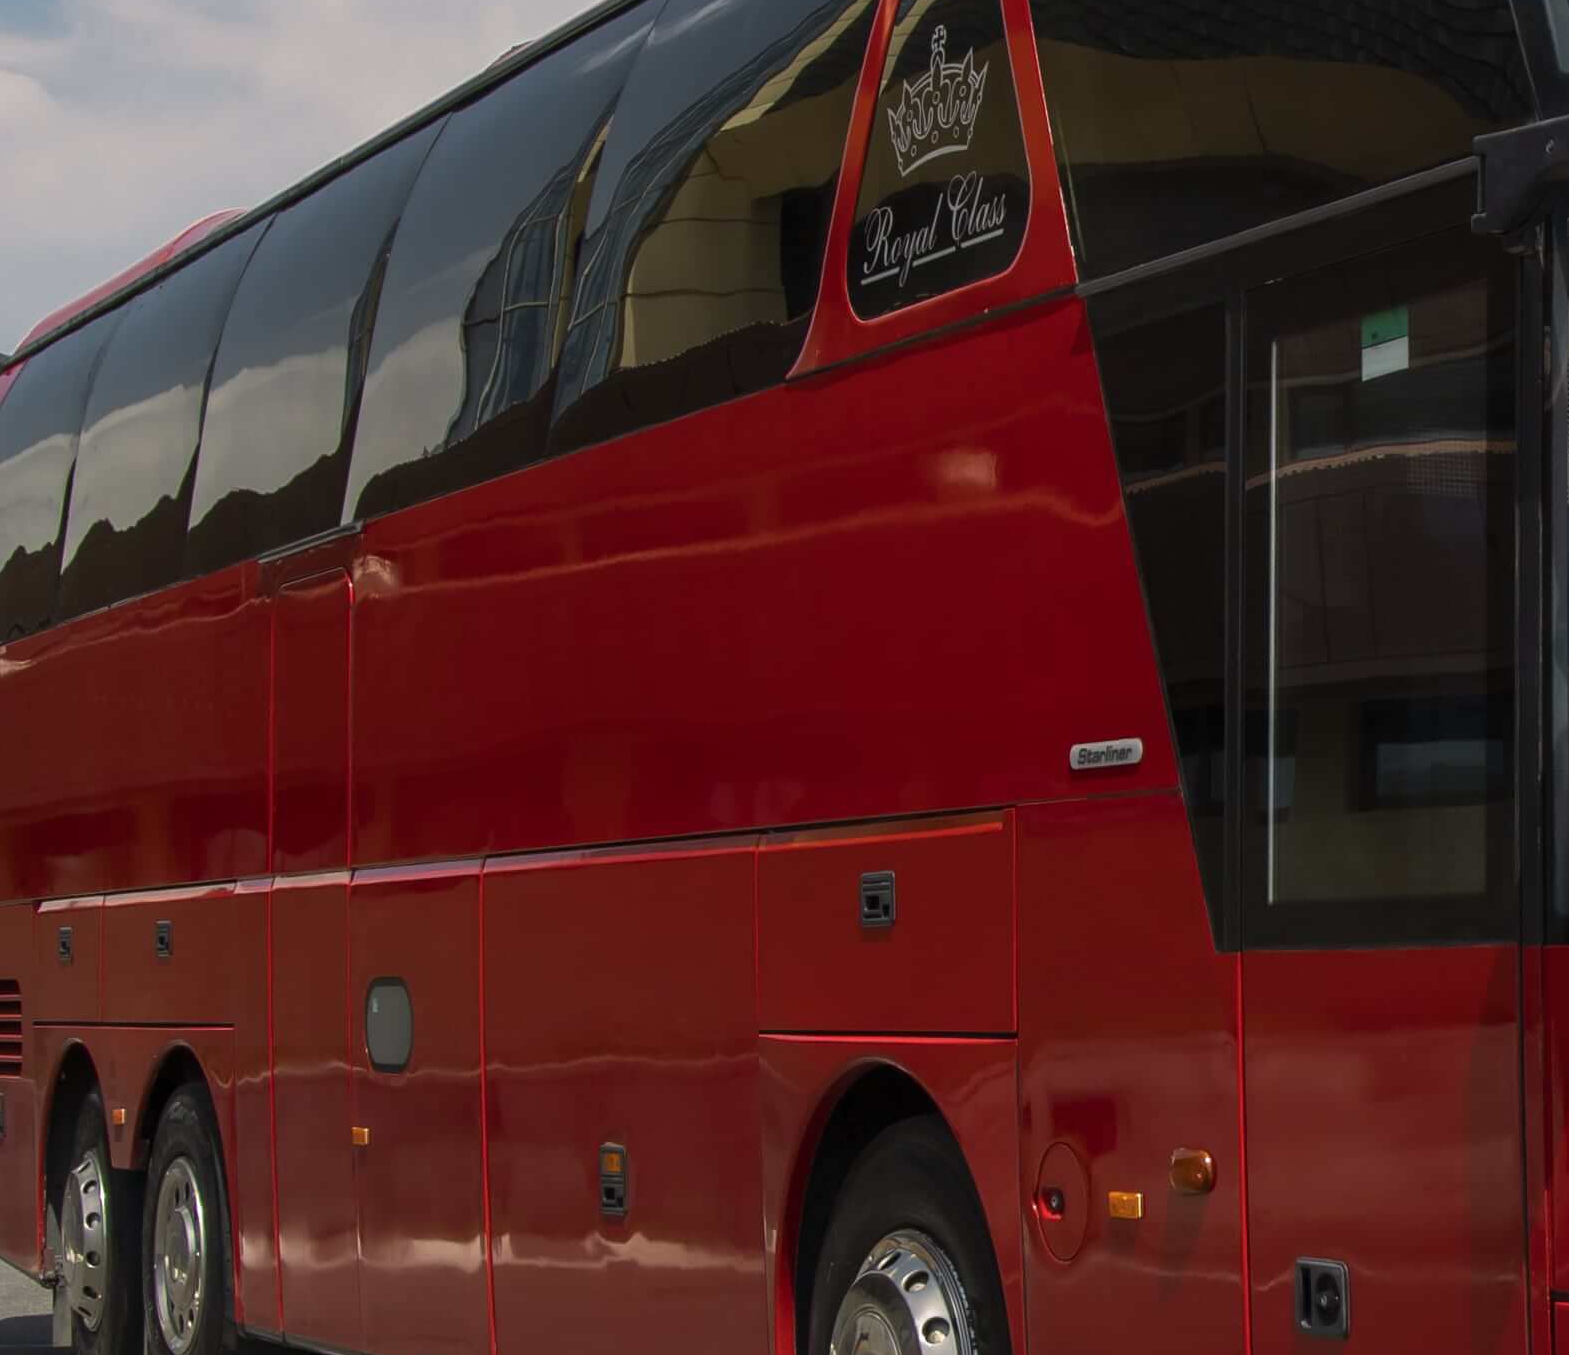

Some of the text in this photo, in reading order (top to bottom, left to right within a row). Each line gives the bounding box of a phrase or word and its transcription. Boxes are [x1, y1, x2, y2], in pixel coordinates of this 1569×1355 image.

[863, 171, 1006, 287] Royal Class
[1077, 745, 1133, 765] Starliner
